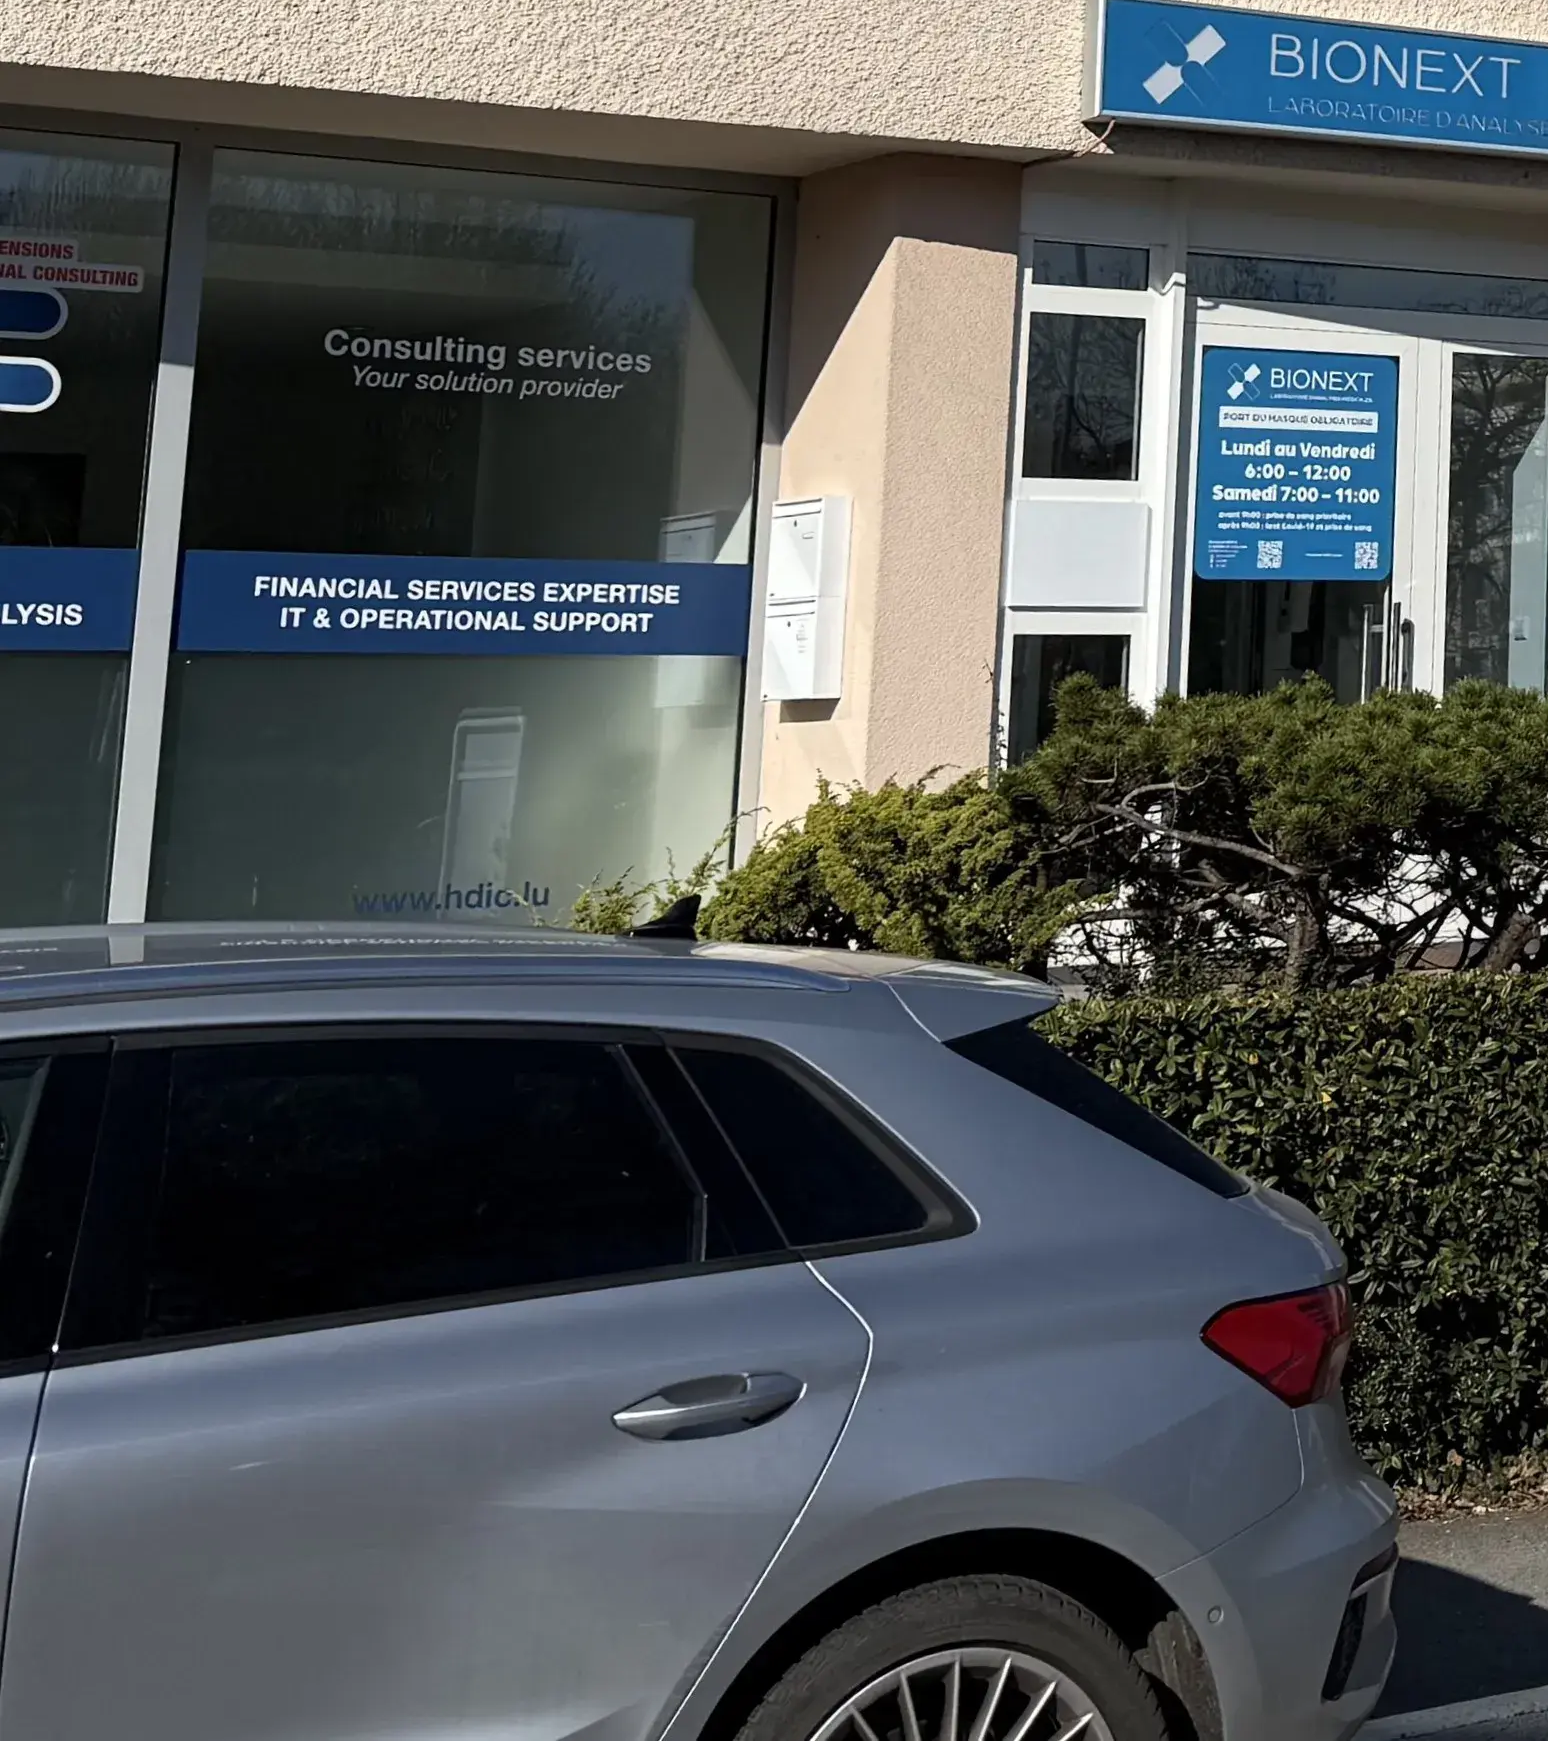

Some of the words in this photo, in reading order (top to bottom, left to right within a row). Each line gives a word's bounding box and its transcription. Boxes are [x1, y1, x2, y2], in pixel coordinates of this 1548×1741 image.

[1270, 33, 1522, 99] BIONEXT
[1267, 96, 1431, 127] LABORATOIRE
[33, 265, 139, 287] CONSULTING
[324, 328, 506, 371] Consulting
[518, 345, 652, 373] services
[351, 365, 410, 388] Your
[415, 369, 513, 394] solution
[519, 377, 623, 399] provider
[1270, 367, 1374, 392] BIONEXT
[1221, 439, 1271, 457] Lundi
[1274, 445, 1296, 458] au
[1299, 442, 1375, 460] Vendredi
[1245, 463, 1285, 479] 6:00
[1302, 464, 1351, 481] 12:00
[1212, 484, 1277, 502] Samedi
[1281, 486, 1319, 502] 7:00
[1335, 487, 1380, 504] 11:00
[253, 575, 400, 600] FINANCIAL
[407, 579, 536, 603] SERVICES
[543, 582, 681, 605] EXPERTISE
[0, 603, 83, 626] LYSIS
[279, 607, 306, 628] IT
[313, 609, 332, 629] &
[340, 608, 526, 631] OPERATIONAL
[533, 611, 654, 633] SUPPORT
